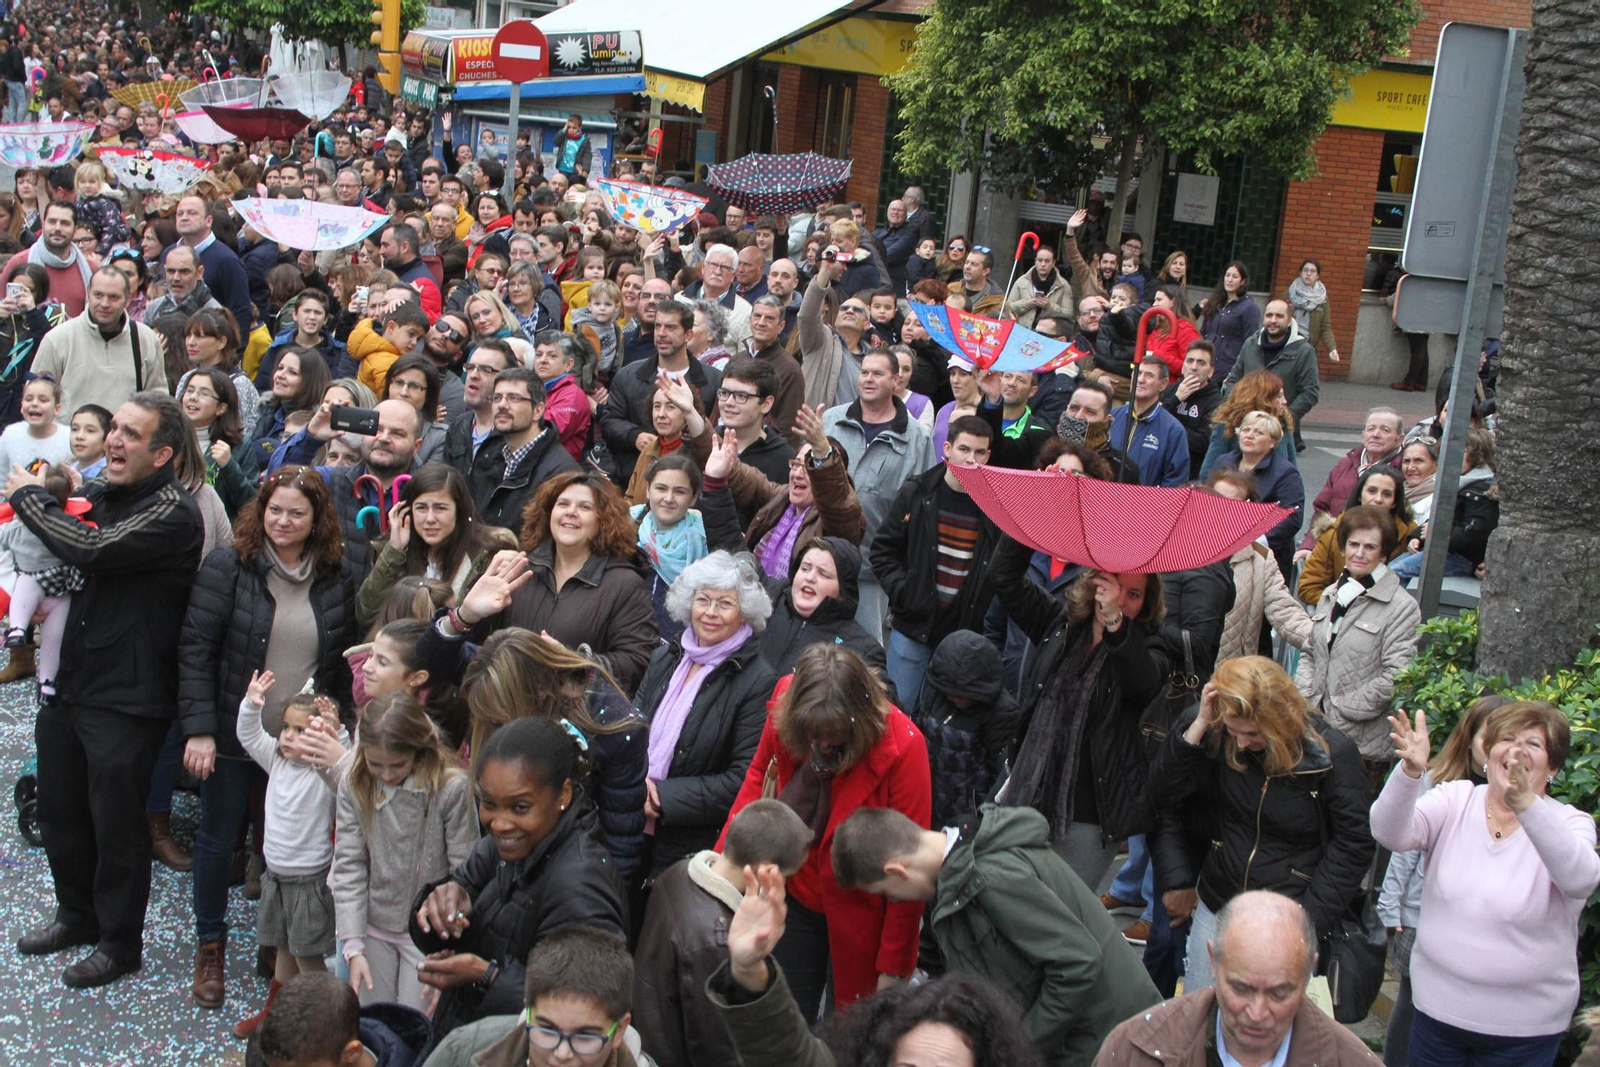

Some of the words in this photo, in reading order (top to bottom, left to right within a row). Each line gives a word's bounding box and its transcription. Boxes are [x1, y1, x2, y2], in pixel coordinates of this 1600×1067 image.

[459, 71, 497, 80] CHUCHES
[1376, 91, 1404, 103] SPORT
[1176, 402, 1199, 418] ILA
